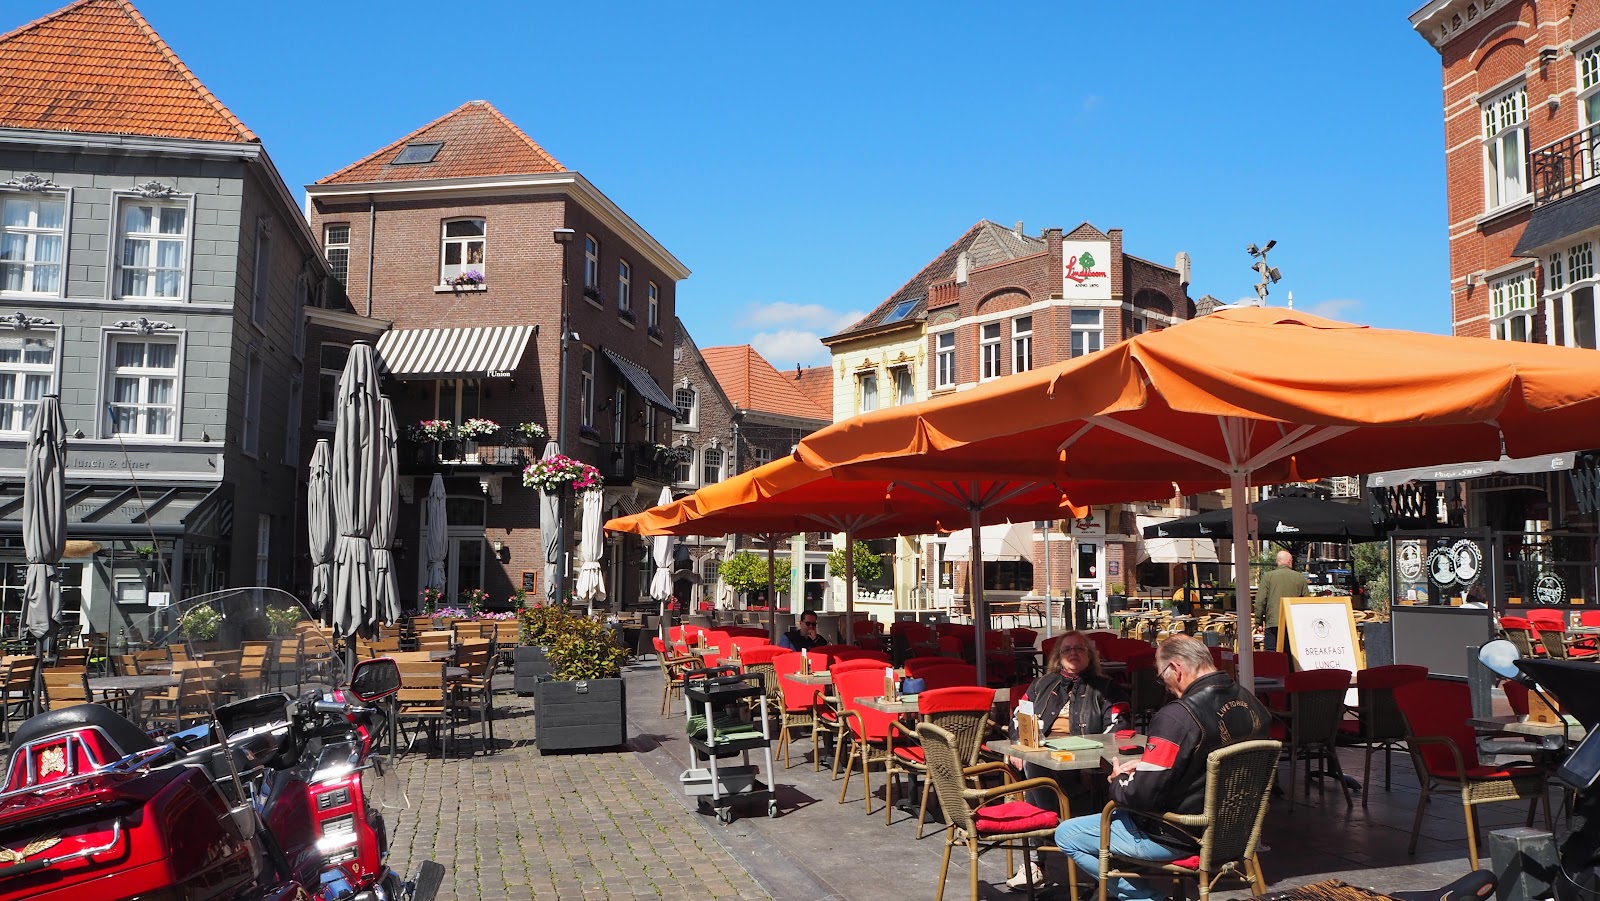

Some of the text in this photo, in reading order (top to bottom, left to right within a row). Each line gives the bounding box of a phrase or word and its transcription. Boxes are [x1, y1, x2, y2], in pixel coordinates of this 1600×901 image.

[1065, 255, 1107, 283] Lindeboom
[74, 458, 150, 469] lunch & diner
[1305, 647, 1345, 655] BREAKFAST
[1314, 661, 1340, 669] LUNCH
[1216, 703, 1231, 718] LIVE
[1236, 700, 1249, 709] RIDE
